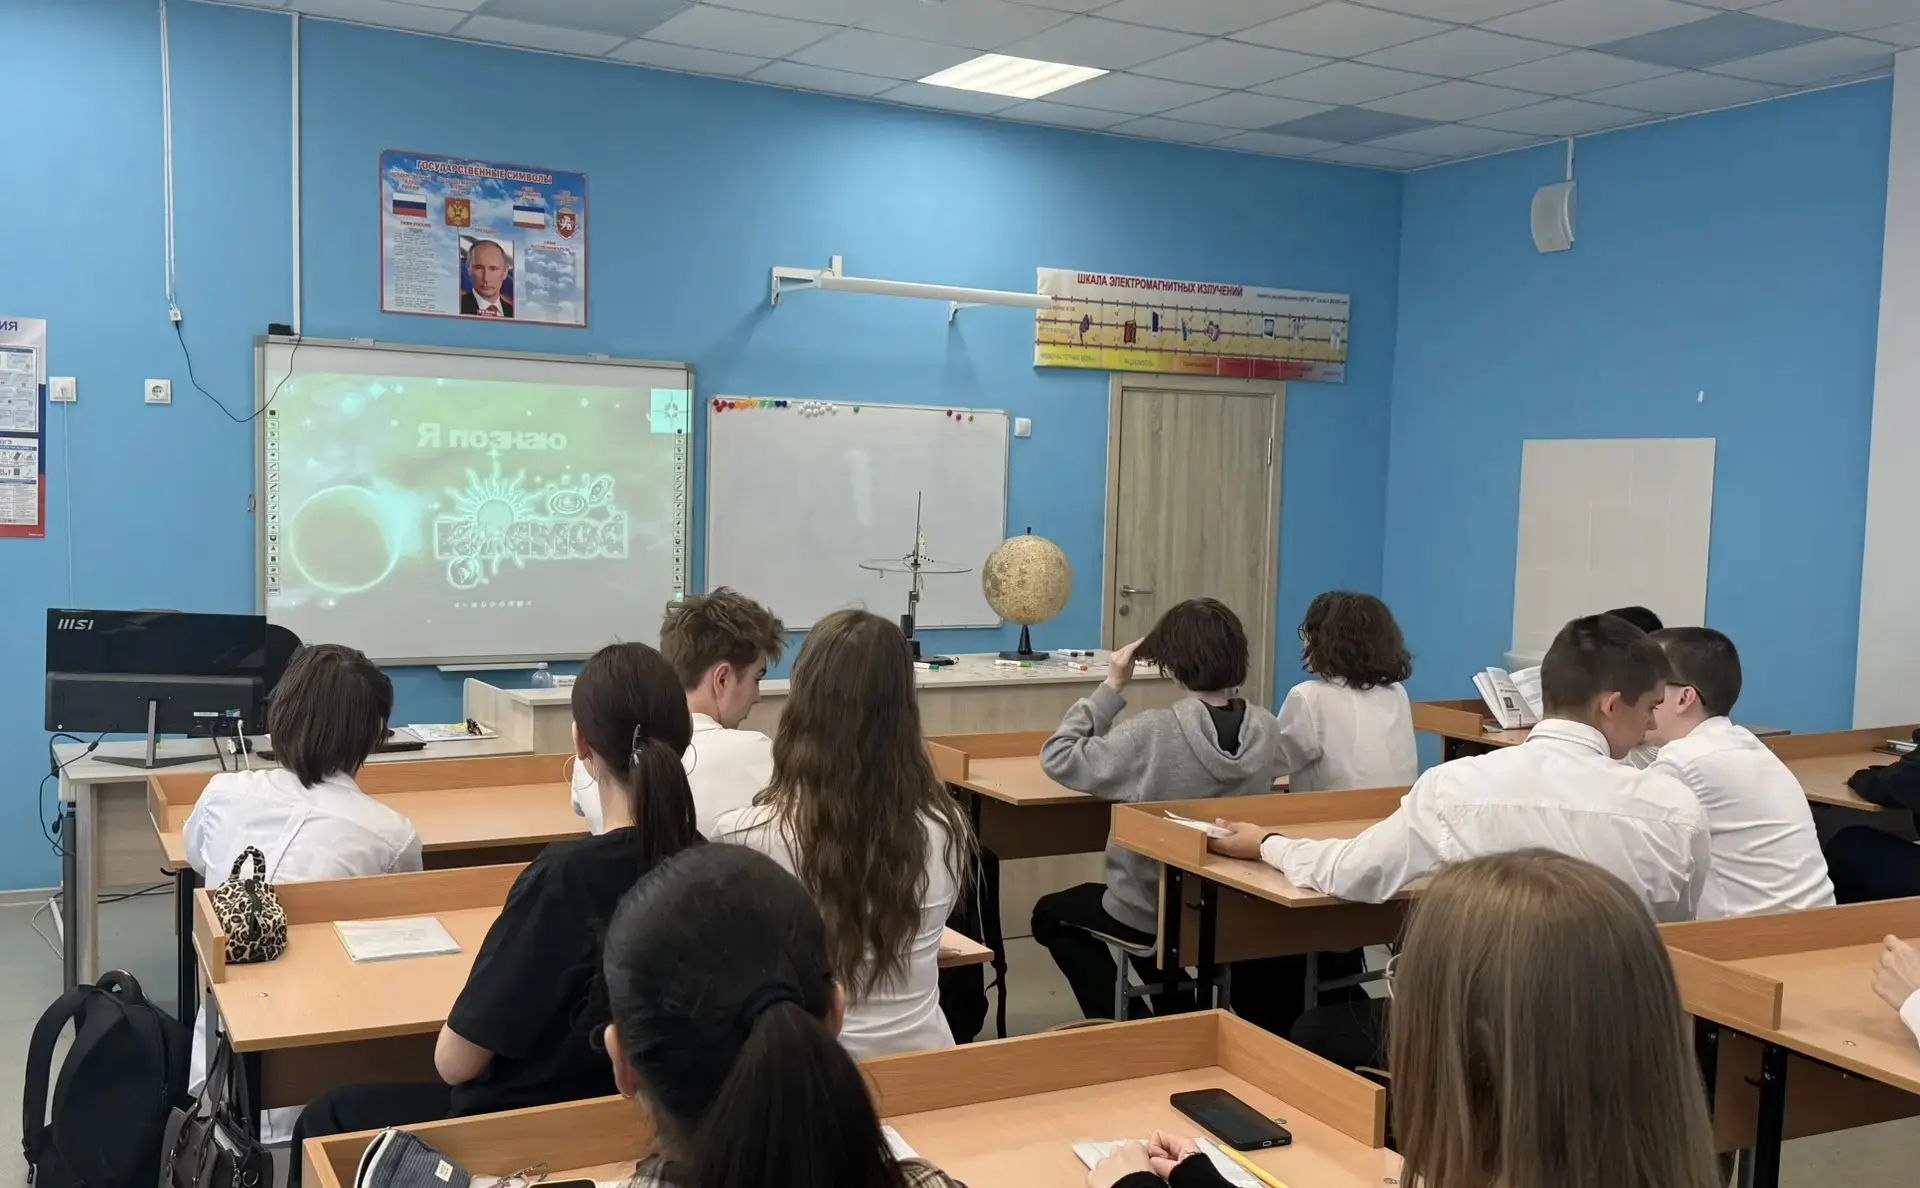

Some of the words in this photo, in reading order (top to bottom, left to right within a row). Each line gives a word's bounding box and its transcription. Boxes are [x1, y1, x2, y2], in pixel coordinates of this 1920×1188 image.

[416, 160, 505, 179] ГОСУДАРСТВЕННЫЕ
[506, 170, 553, 184] СИМВОЛЫ
[1077, 272, 1108, 286] ШКАЛА
[1109, 275, 1196, 294] ЭЛЕКТРОМАГНИТНЫХ
[1197, 283, 1243, 297] ИЗЛУЧЕНИЙ
[417, 422, 441, 448] Я
[449, 428, 567, 450] познаю
